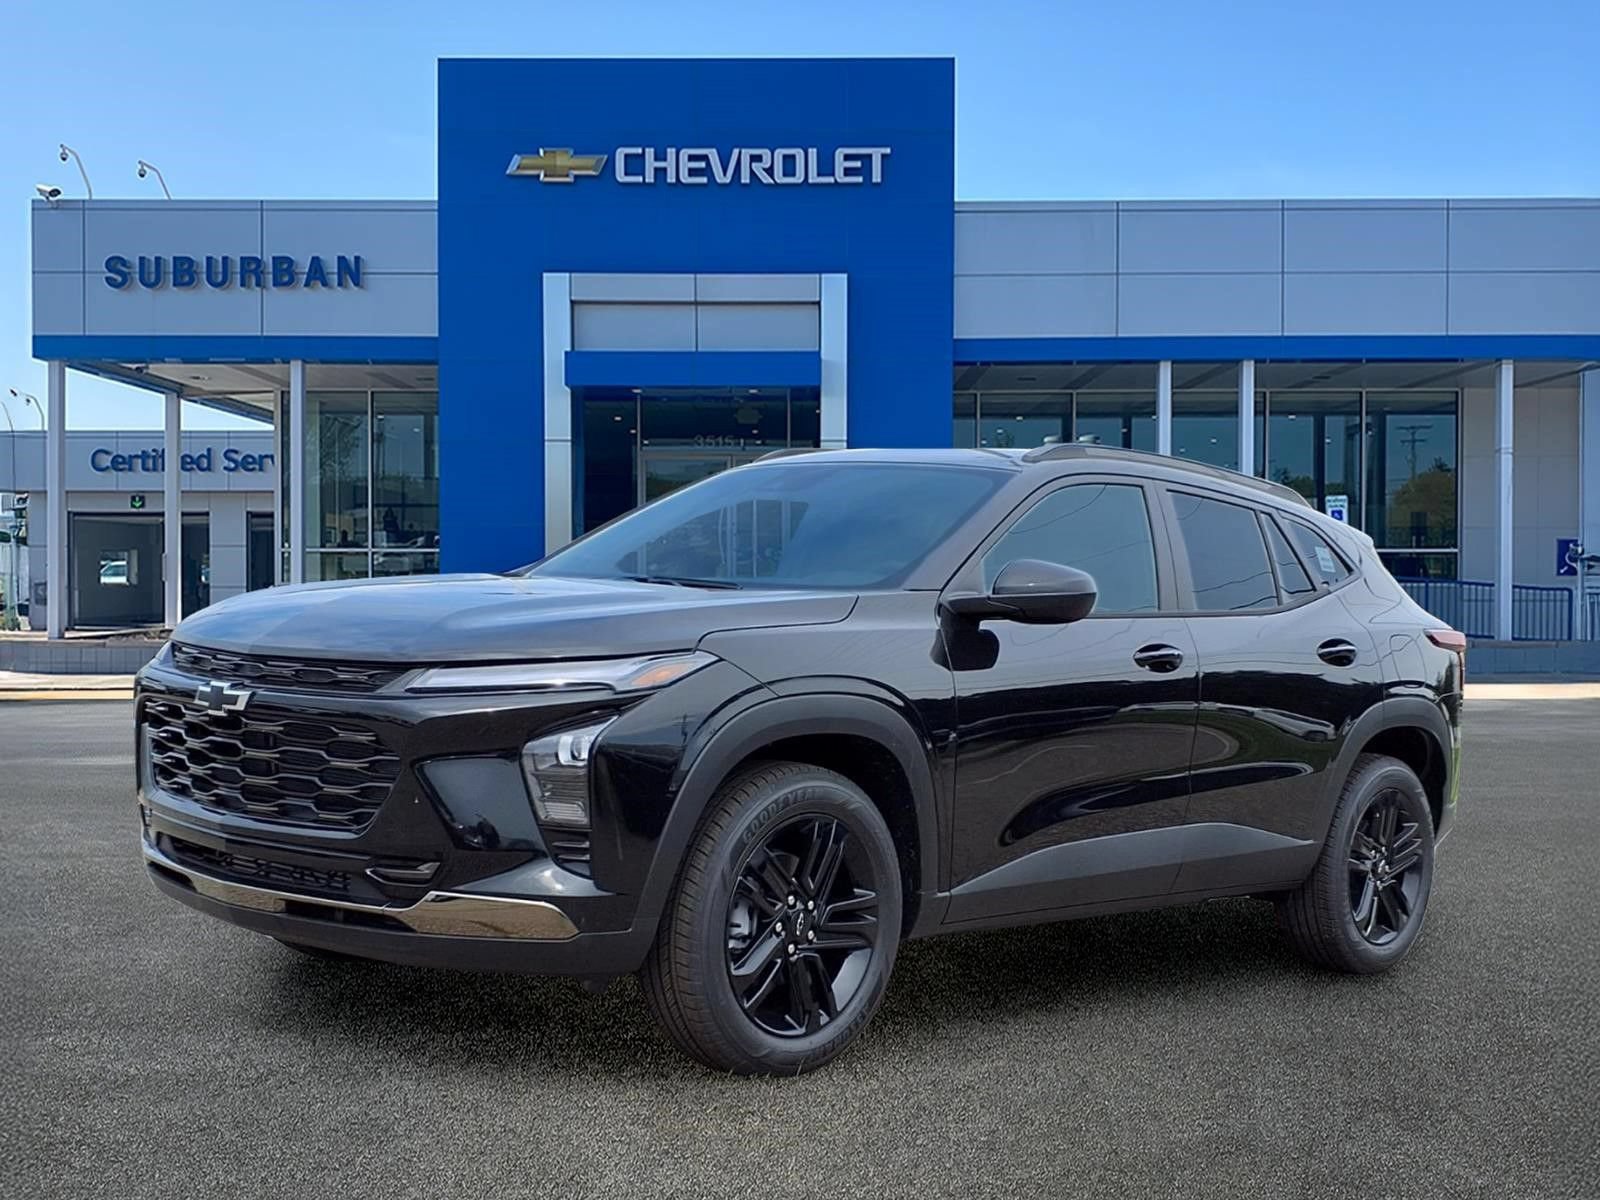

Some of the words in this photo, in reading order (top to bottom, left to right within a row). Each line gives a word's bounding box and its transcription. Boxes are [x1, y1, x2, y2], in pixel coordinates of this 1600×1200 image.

[615, 147, 891, 184] CHEVROLET
[104, 255, 361, 289] SUBURBAN
[91, 447, 212, 472] Certifed
